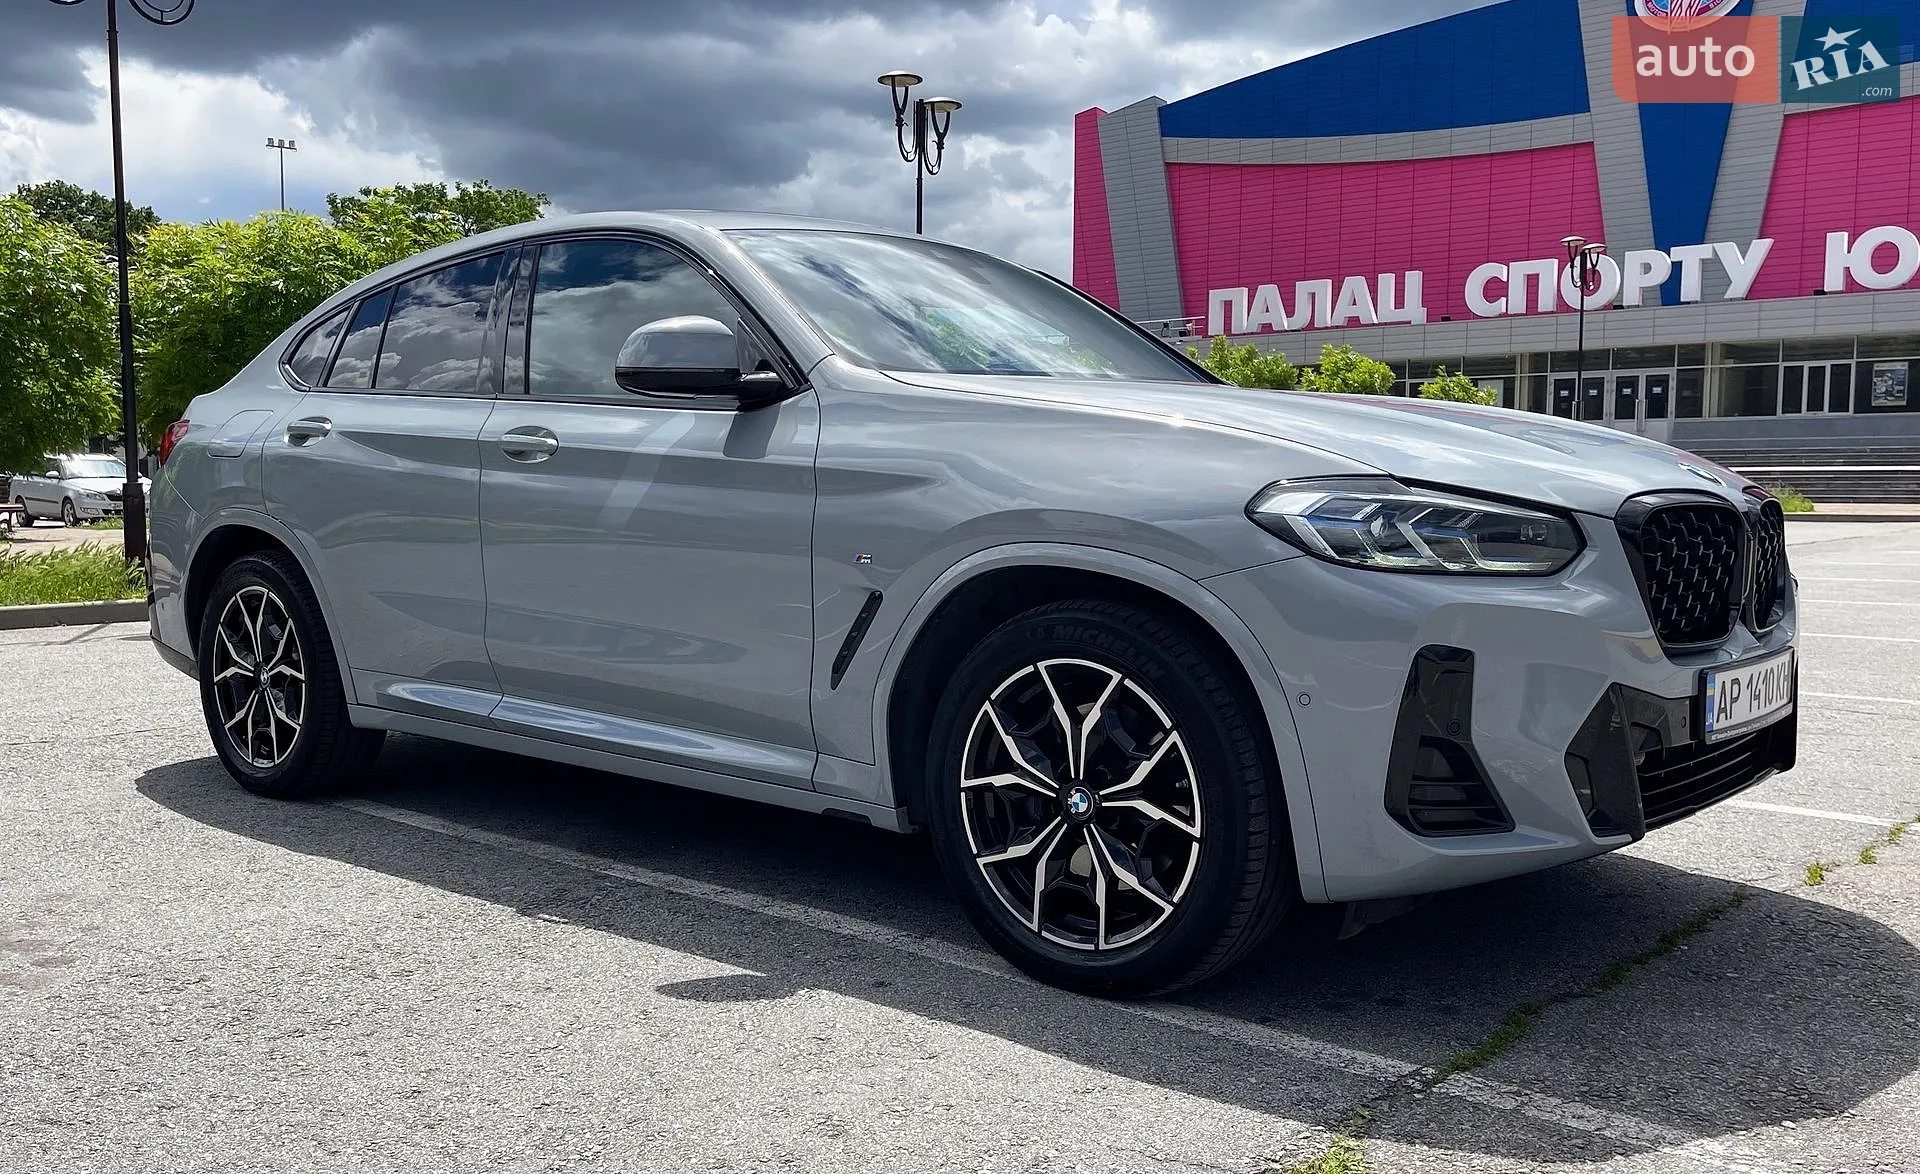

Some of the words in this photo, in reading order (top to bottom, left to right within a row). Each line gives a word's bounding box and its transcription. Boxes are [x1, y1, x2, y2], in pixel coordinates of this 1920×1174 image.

[1208, 270, 1427, 335] ПАЛАЦ
[1465, 238, 1774, 317] СПОРТУ
[1747, 667, 1775, 712] 1410
